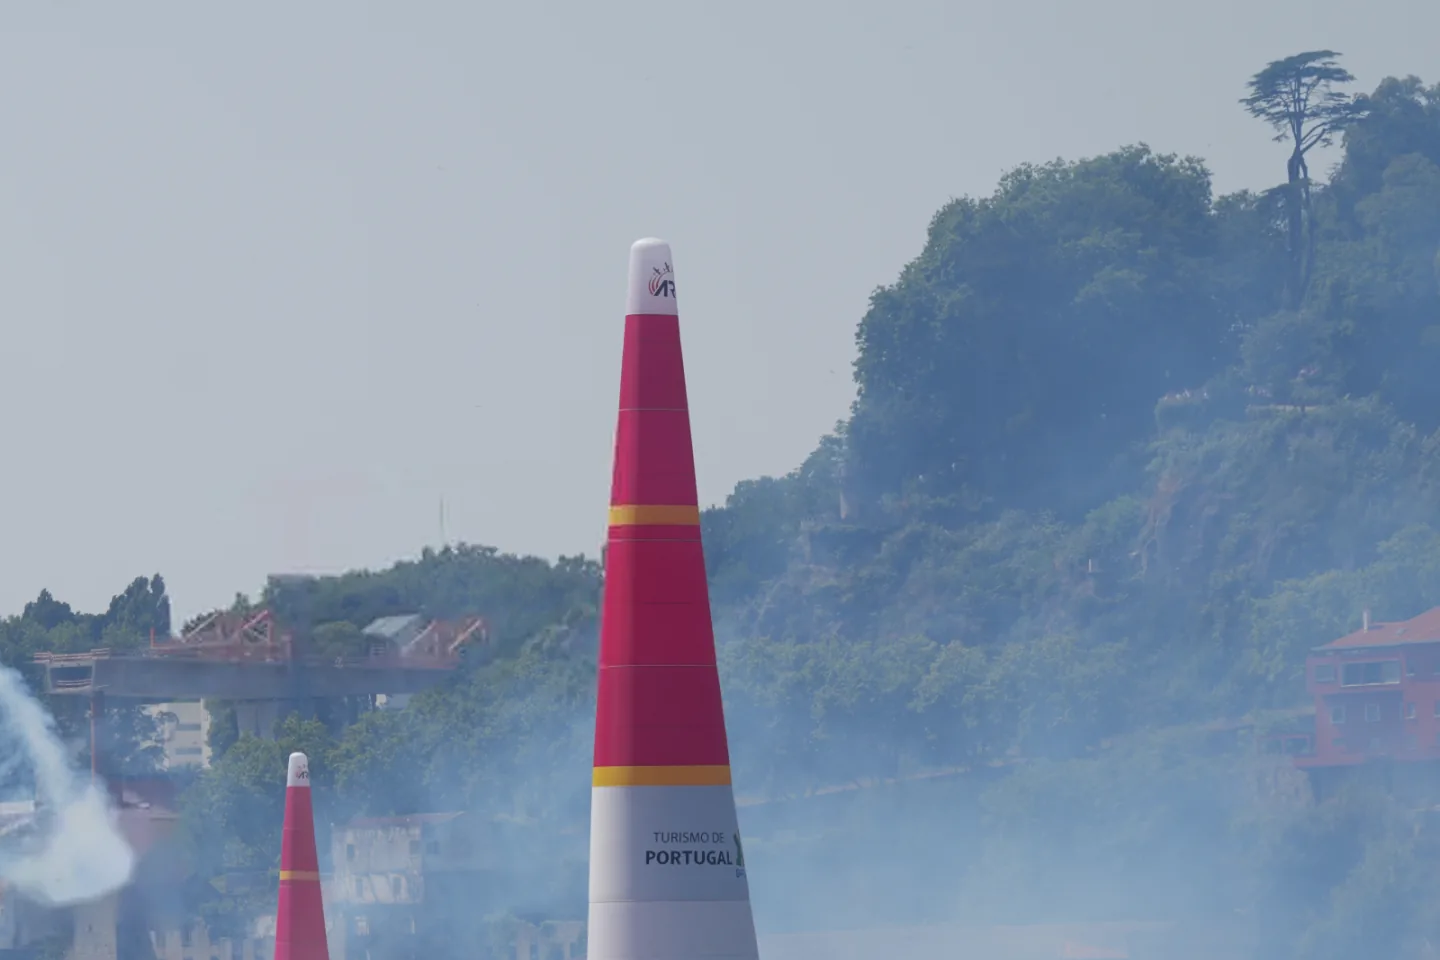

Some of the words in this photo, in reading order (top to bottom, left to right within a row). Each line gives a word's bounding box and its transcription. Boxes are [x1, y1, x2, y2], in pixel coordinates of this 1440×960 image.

[653, 831, 709, 843] TURISMO
[712, 832, 725, 843] DE
[645, 850, 733, 865] PORTUGAL
